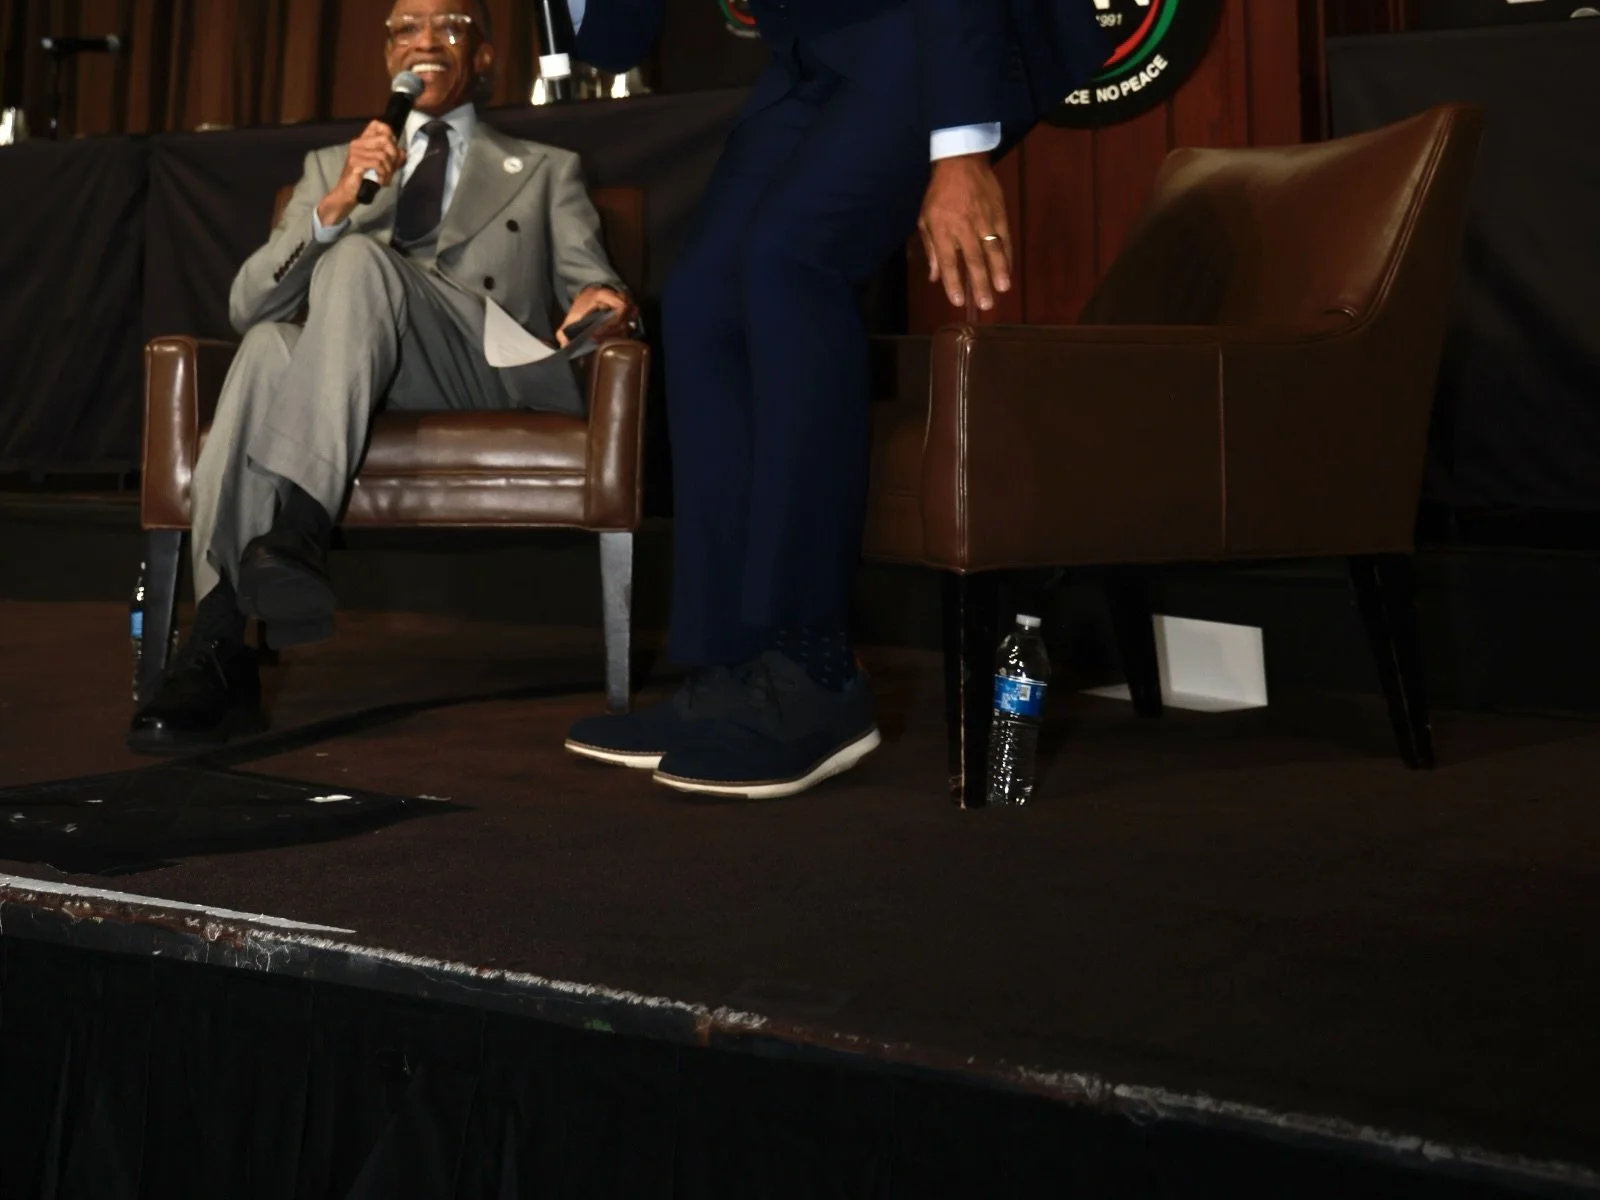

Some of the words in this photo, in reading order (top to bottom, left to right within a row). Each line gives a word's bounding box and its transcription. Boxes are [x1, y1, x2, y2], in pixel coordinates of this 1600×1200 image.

[1064, 89, 1091, 104] CE
[1095, 84, 1120, 104] NO
[1119, 54, 1169, 97] PEACE
